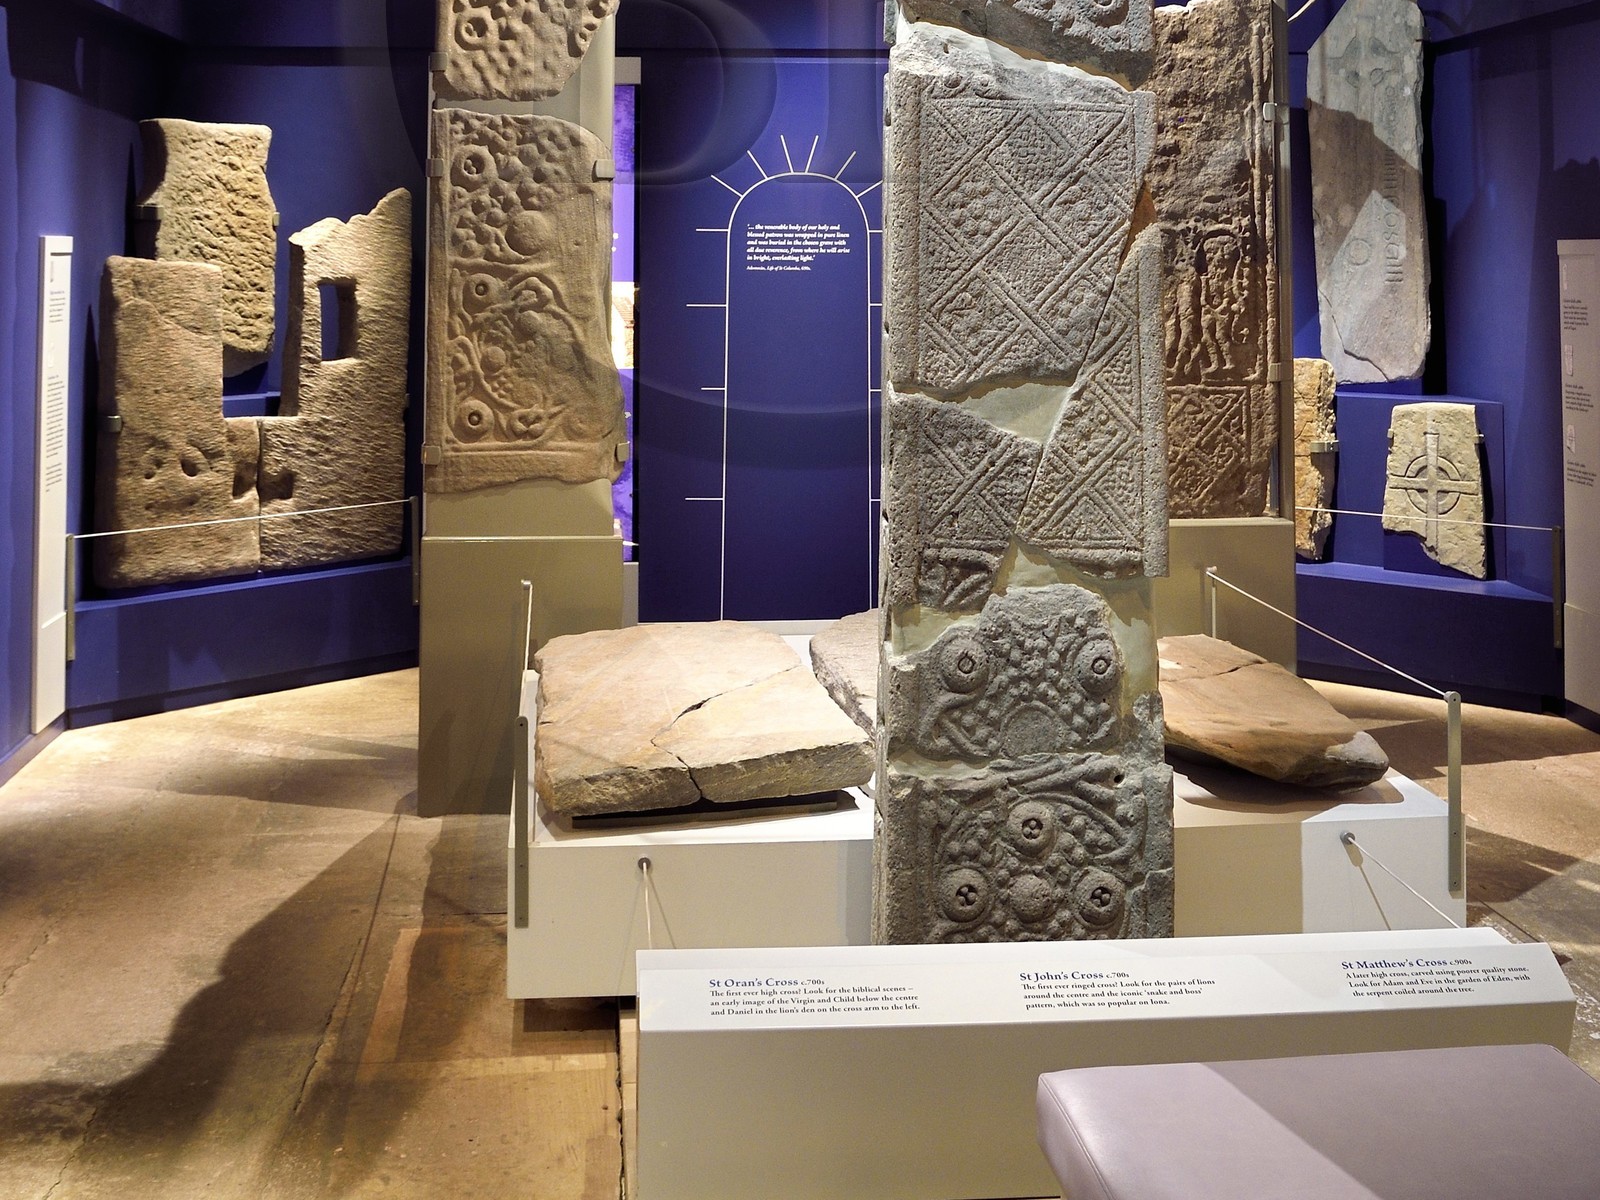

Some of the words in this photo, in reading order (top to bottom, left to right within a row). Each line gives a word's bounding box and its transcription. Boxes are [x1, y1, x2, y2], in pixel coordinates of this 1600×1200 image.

[1341, 961, 1353, 969] St
[1356, 959, 1413, 968] Matthew's
[1415, 958, 1447, 966] Cross
[1481, 966, 1505, 974] quality
[1019, 972, 1031, 980] St
[1034, 972, 1068, 982] John's
[1071, 971, 1104, 980] Cross
[1456, 976, 1481, 984] garden
[709, 979, 720, 987] St
[724, 978, 762, 987] Oran's
[766, 977, 798, 986] Cross
[760, 988, 777, 996] high
[1107, 999, 1136, 1007] popular
